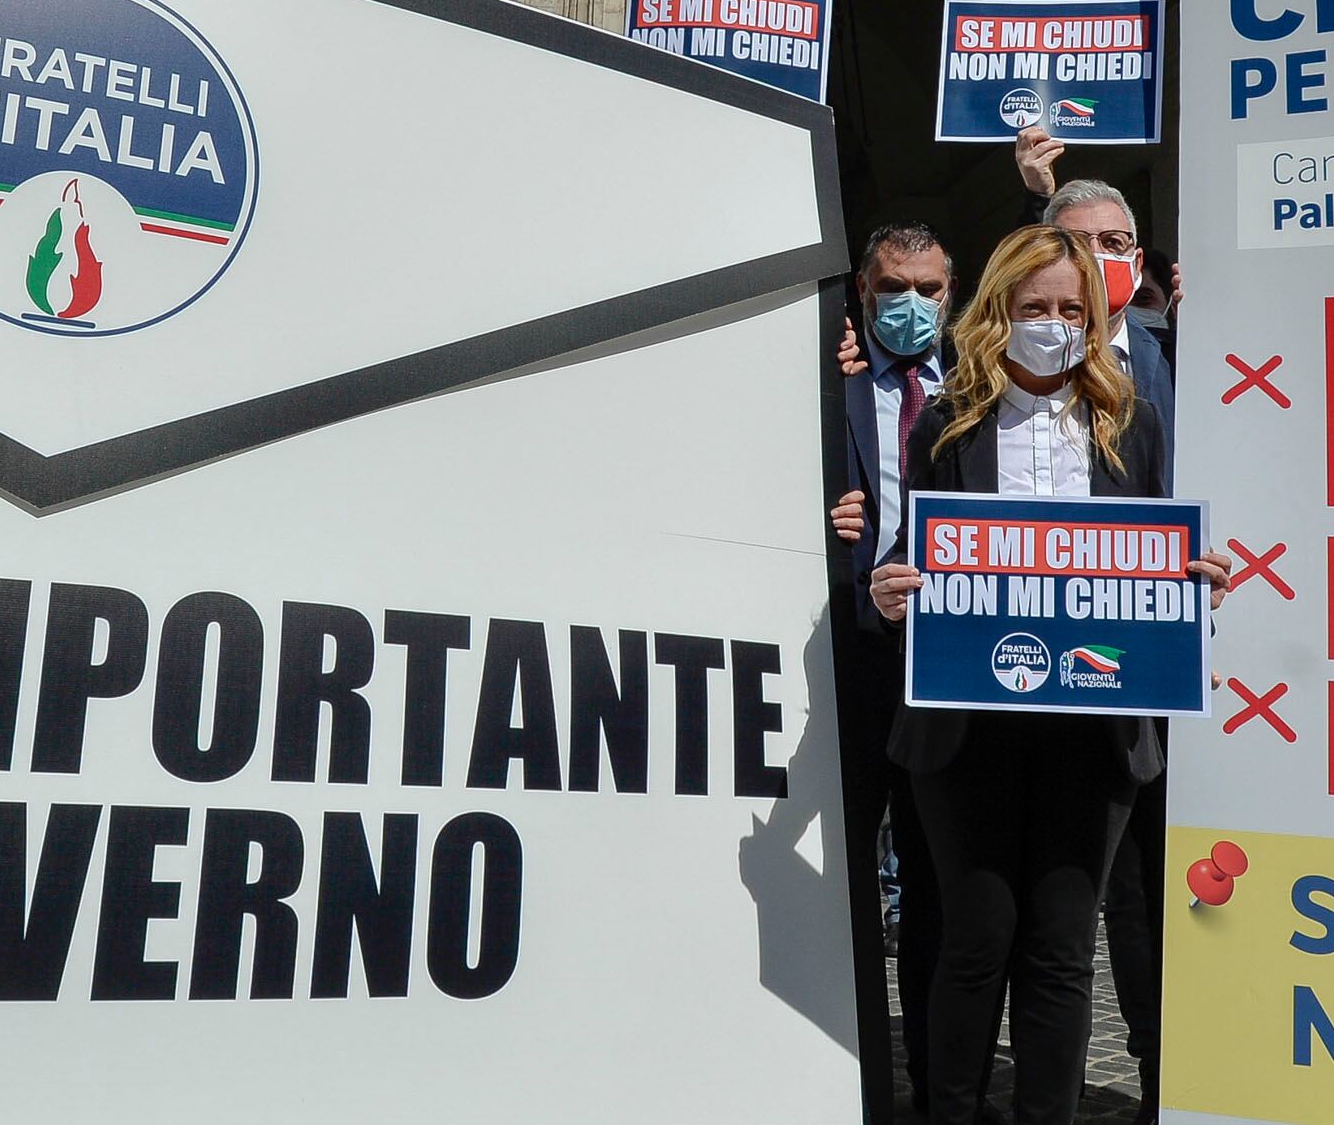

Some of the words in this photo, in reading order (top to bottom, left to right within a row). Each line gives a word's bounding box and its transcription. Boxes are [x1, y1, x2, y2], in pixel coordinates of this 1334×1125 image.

[691, 28, 725, 57] MI
[732, 30, 820, 70] CHIEDI
[961, 19, 995, 49] SE
[1000, 20, 1037, 49] MI
[1042, 19, 1143, 50] CHIUDI
[948, 52, 1007, 81] NON
[1013, 52, 1050, 81] MI
[1056, 51, 1152, 82] CHIEDI
[933, 523, 979, 567] SE
[988, 525, 1036, 568] MI
[1045, 527, 1181, 572] CHIUDI
[919, 572, 998, 616] NON
[1007, 575, 1055, 618] MI
[1065, 577, 1196, 623] CHIEDI
[997, 654, 1046, 665] d'ITALIA
[1001, 644, 1042, 654] FRATELLI
[1077, 680, 1122, 688] NAZIONALE
